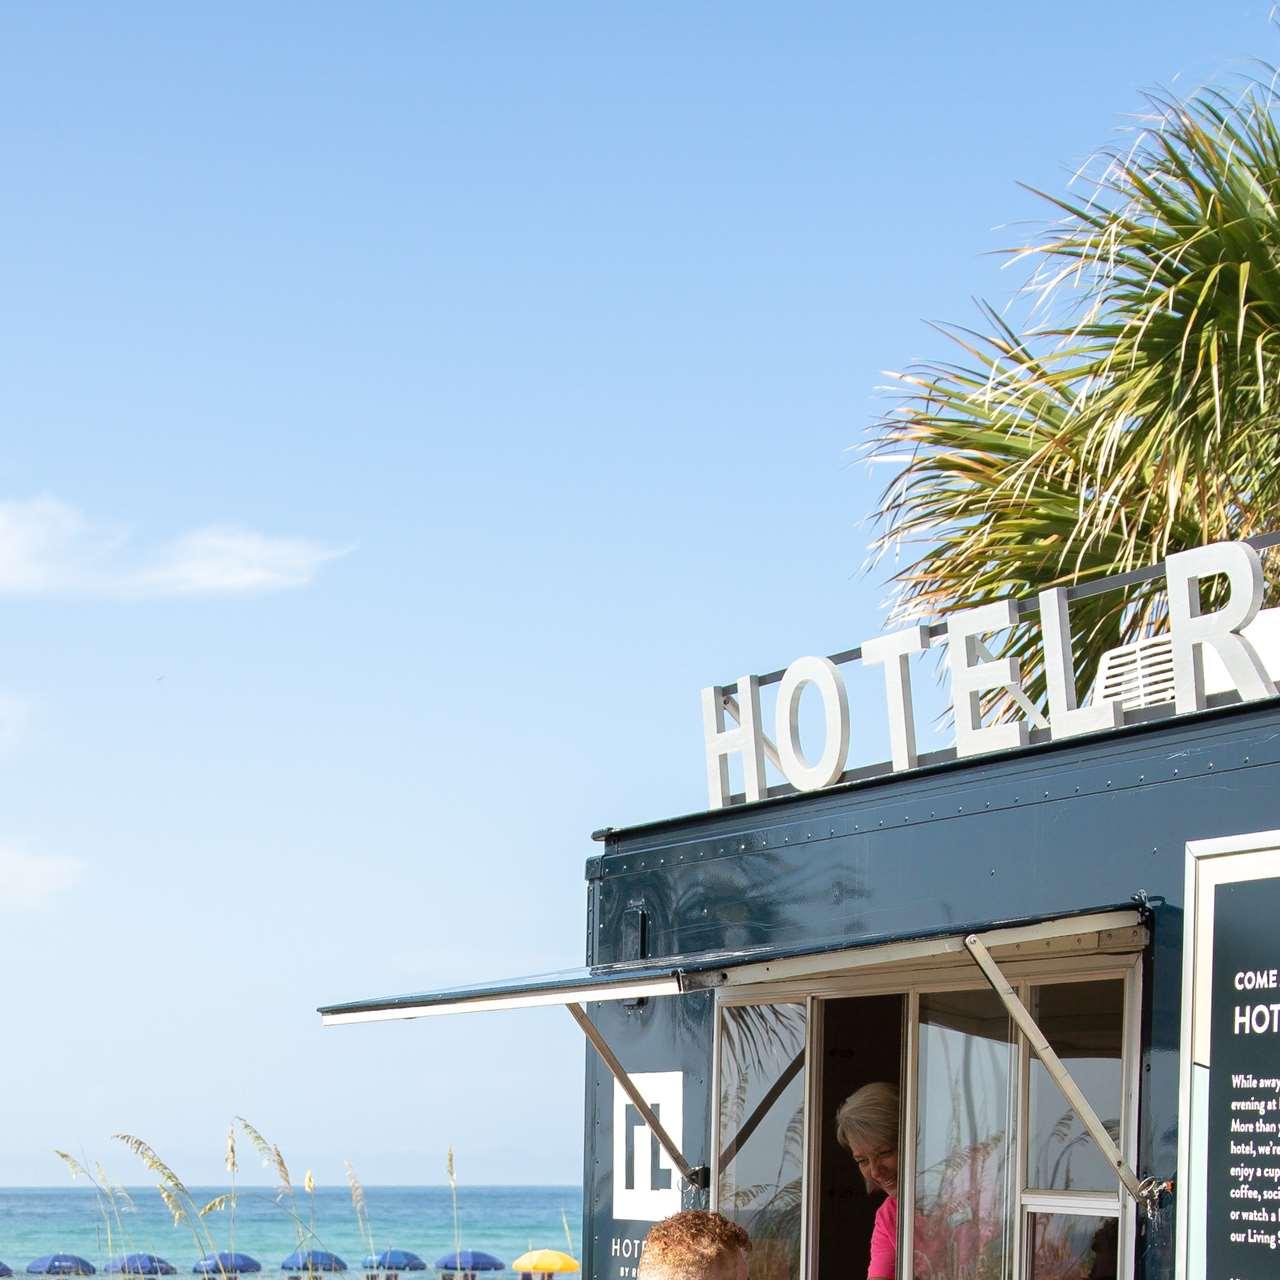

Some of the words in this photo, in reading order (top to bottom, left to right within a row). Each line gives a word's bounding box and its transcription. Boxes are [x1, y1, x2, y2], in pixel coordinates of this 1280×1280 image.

[700, 586, 1121, 810] HOTEL
[1234, 969, 1278, 990] COME
[1231, 1074, 1257, 1089] While
[1230, 1097, 1265, 1115] evening
[1267, 1098, 1277, 1110] at
[1230, 1118, 1254, 1132] More
[1255, 1118, 1276, 1132] than
[1230, 1140, 1256, 1157] hotel,
[1230, 1163, 1254, 1181] enjoy
[1256, 1167, 1261, 1177] a
[1263, 1167, 1280, 1182] cup
[1230, 1184, 1261, 1202] coffee,
[1230, 1211, 1240, 1220] or
[1241, 1207, 1268, 1221] watch
[1271, 1212, 1276, 1222] a
[611, 1238, 647, 1258] HOT
[1230, 1232, 1246, 1242] our
[1247, 1229, 1276, 1249] Living
[620, 1266, 629, 1277] BY
